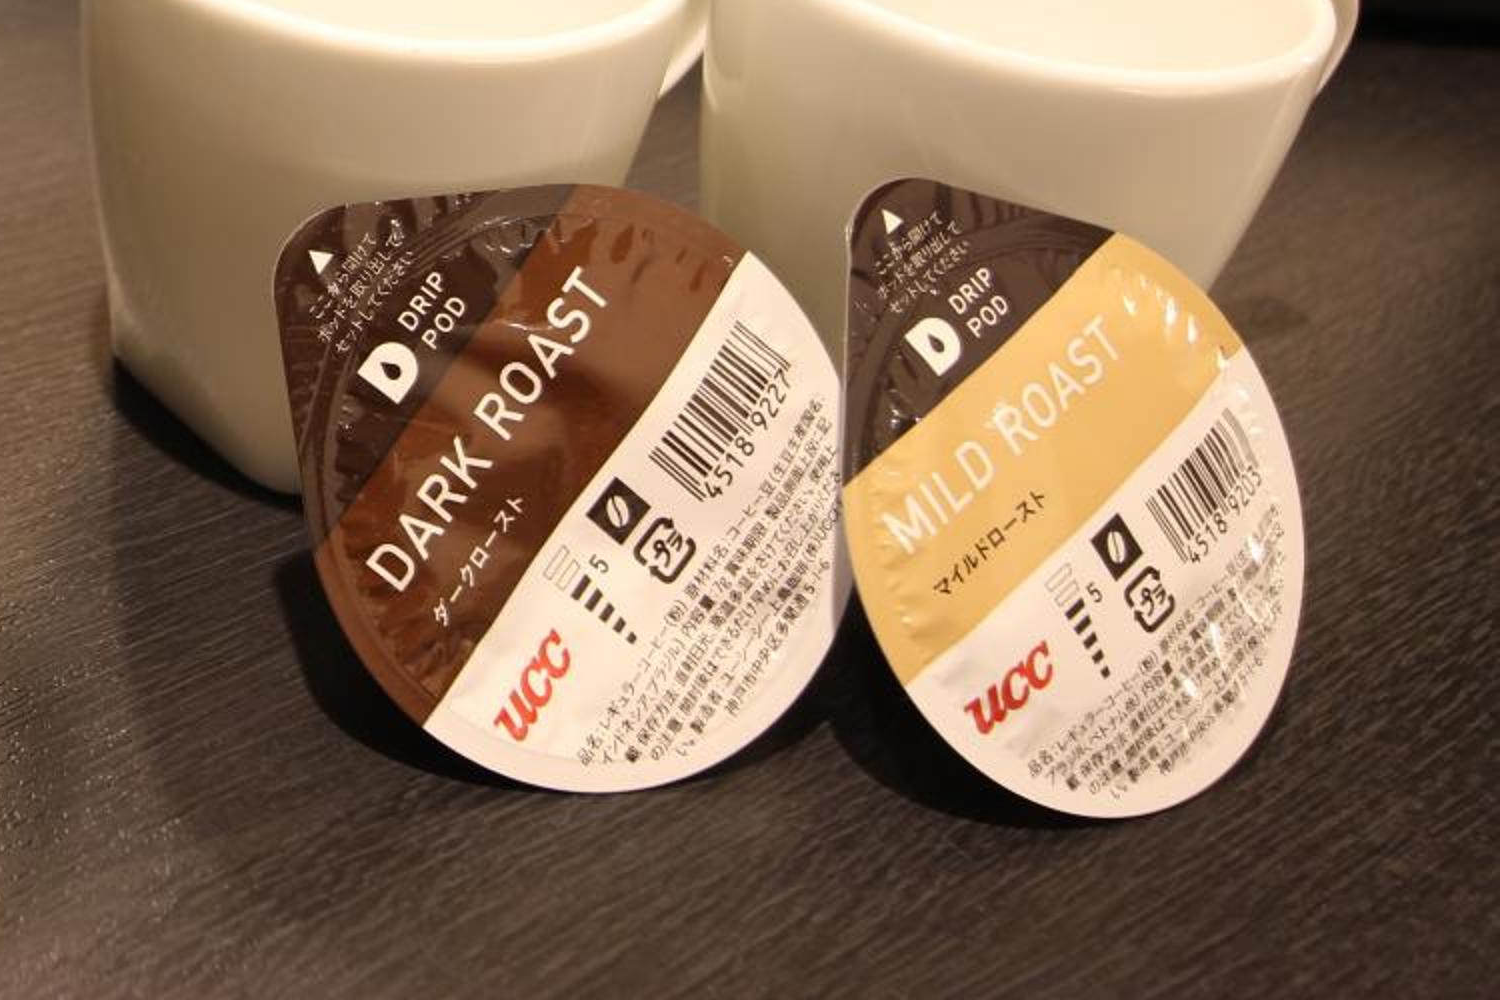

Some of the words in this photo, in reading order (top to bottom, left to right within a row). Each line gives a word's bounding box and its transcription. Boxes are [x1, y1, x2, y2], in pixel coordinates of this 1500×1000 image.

[398, 270, 444, 332] DRIP
[948, 267, 993, 315] DRIP
[966, 295, 1009, 338] POD
[421, 296, 467, 350] POD
[366, 436, 494, 592] DARK
[474, 266, 607, 441] ROAST
[704, 438, 756, 499] 4518
[751, 368, 792, 430] 9227
[881, 441, 995, 555] MILD
[992, 315, 1119, 456] ROAST
[934, 490, 1046, 595] マイルドロースト
[1187, 511, 1228, 563] 4518
[1229, 465, 1263, 516] 9203
[433, 497, 524, 626] ダークロースト
[588, 554, 609, 574] 5
[653, 530, 683, 568] プラ
[1087, 582, 1103, 604] 5
[1141, 584, 1167, 617] プラ
